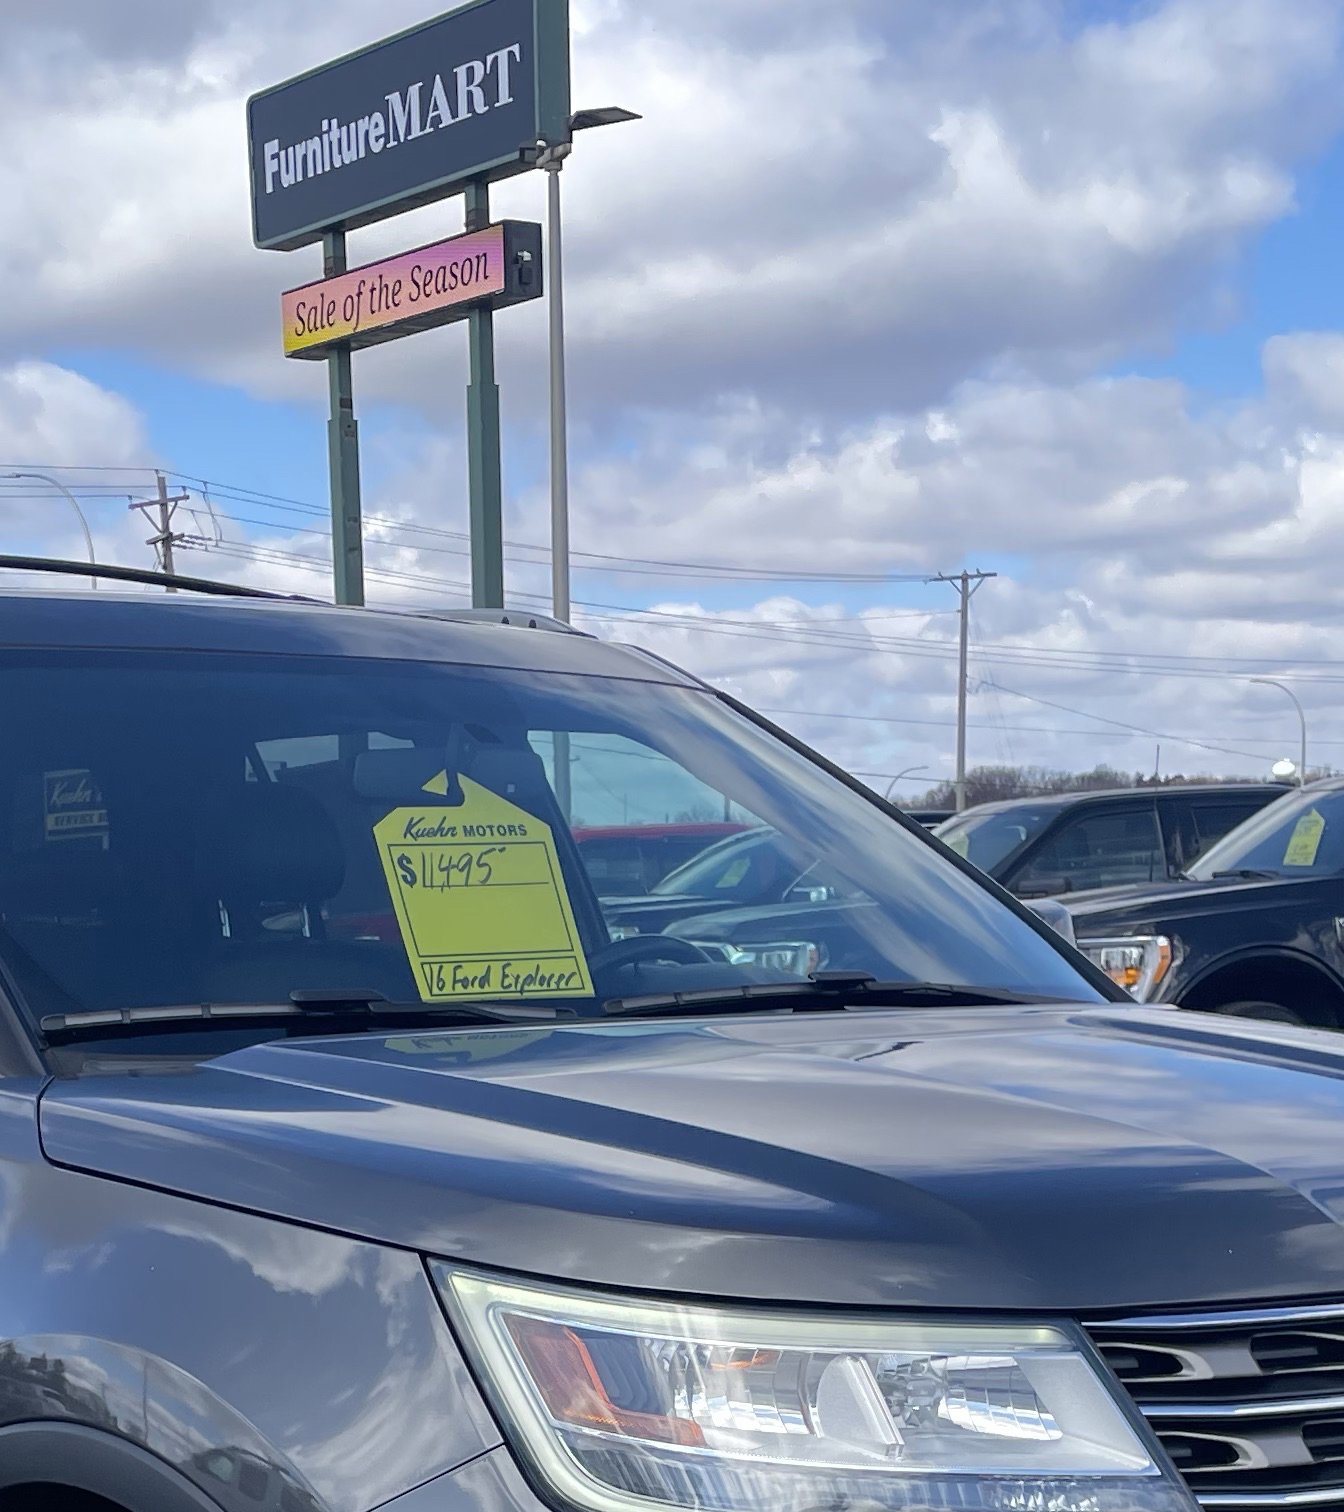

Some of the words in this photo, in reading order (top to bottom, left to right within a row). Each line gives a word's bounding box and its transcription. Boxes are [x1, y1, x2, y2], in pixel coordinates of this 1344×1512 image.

[263, 42, 521, 195] FurnitureMART
[294, 291, 336, 337] Sale
[343, 279, 366, 332] of
[368, 271, 403, 314] the
[408, 250, 490, 303] Season
[403, 815, 458, 842] Kuehn
[463, 823, 528, 837] MOTORS
[452, 963, 491, 992] Ford
[500, 962, 577, 996] Explorer
